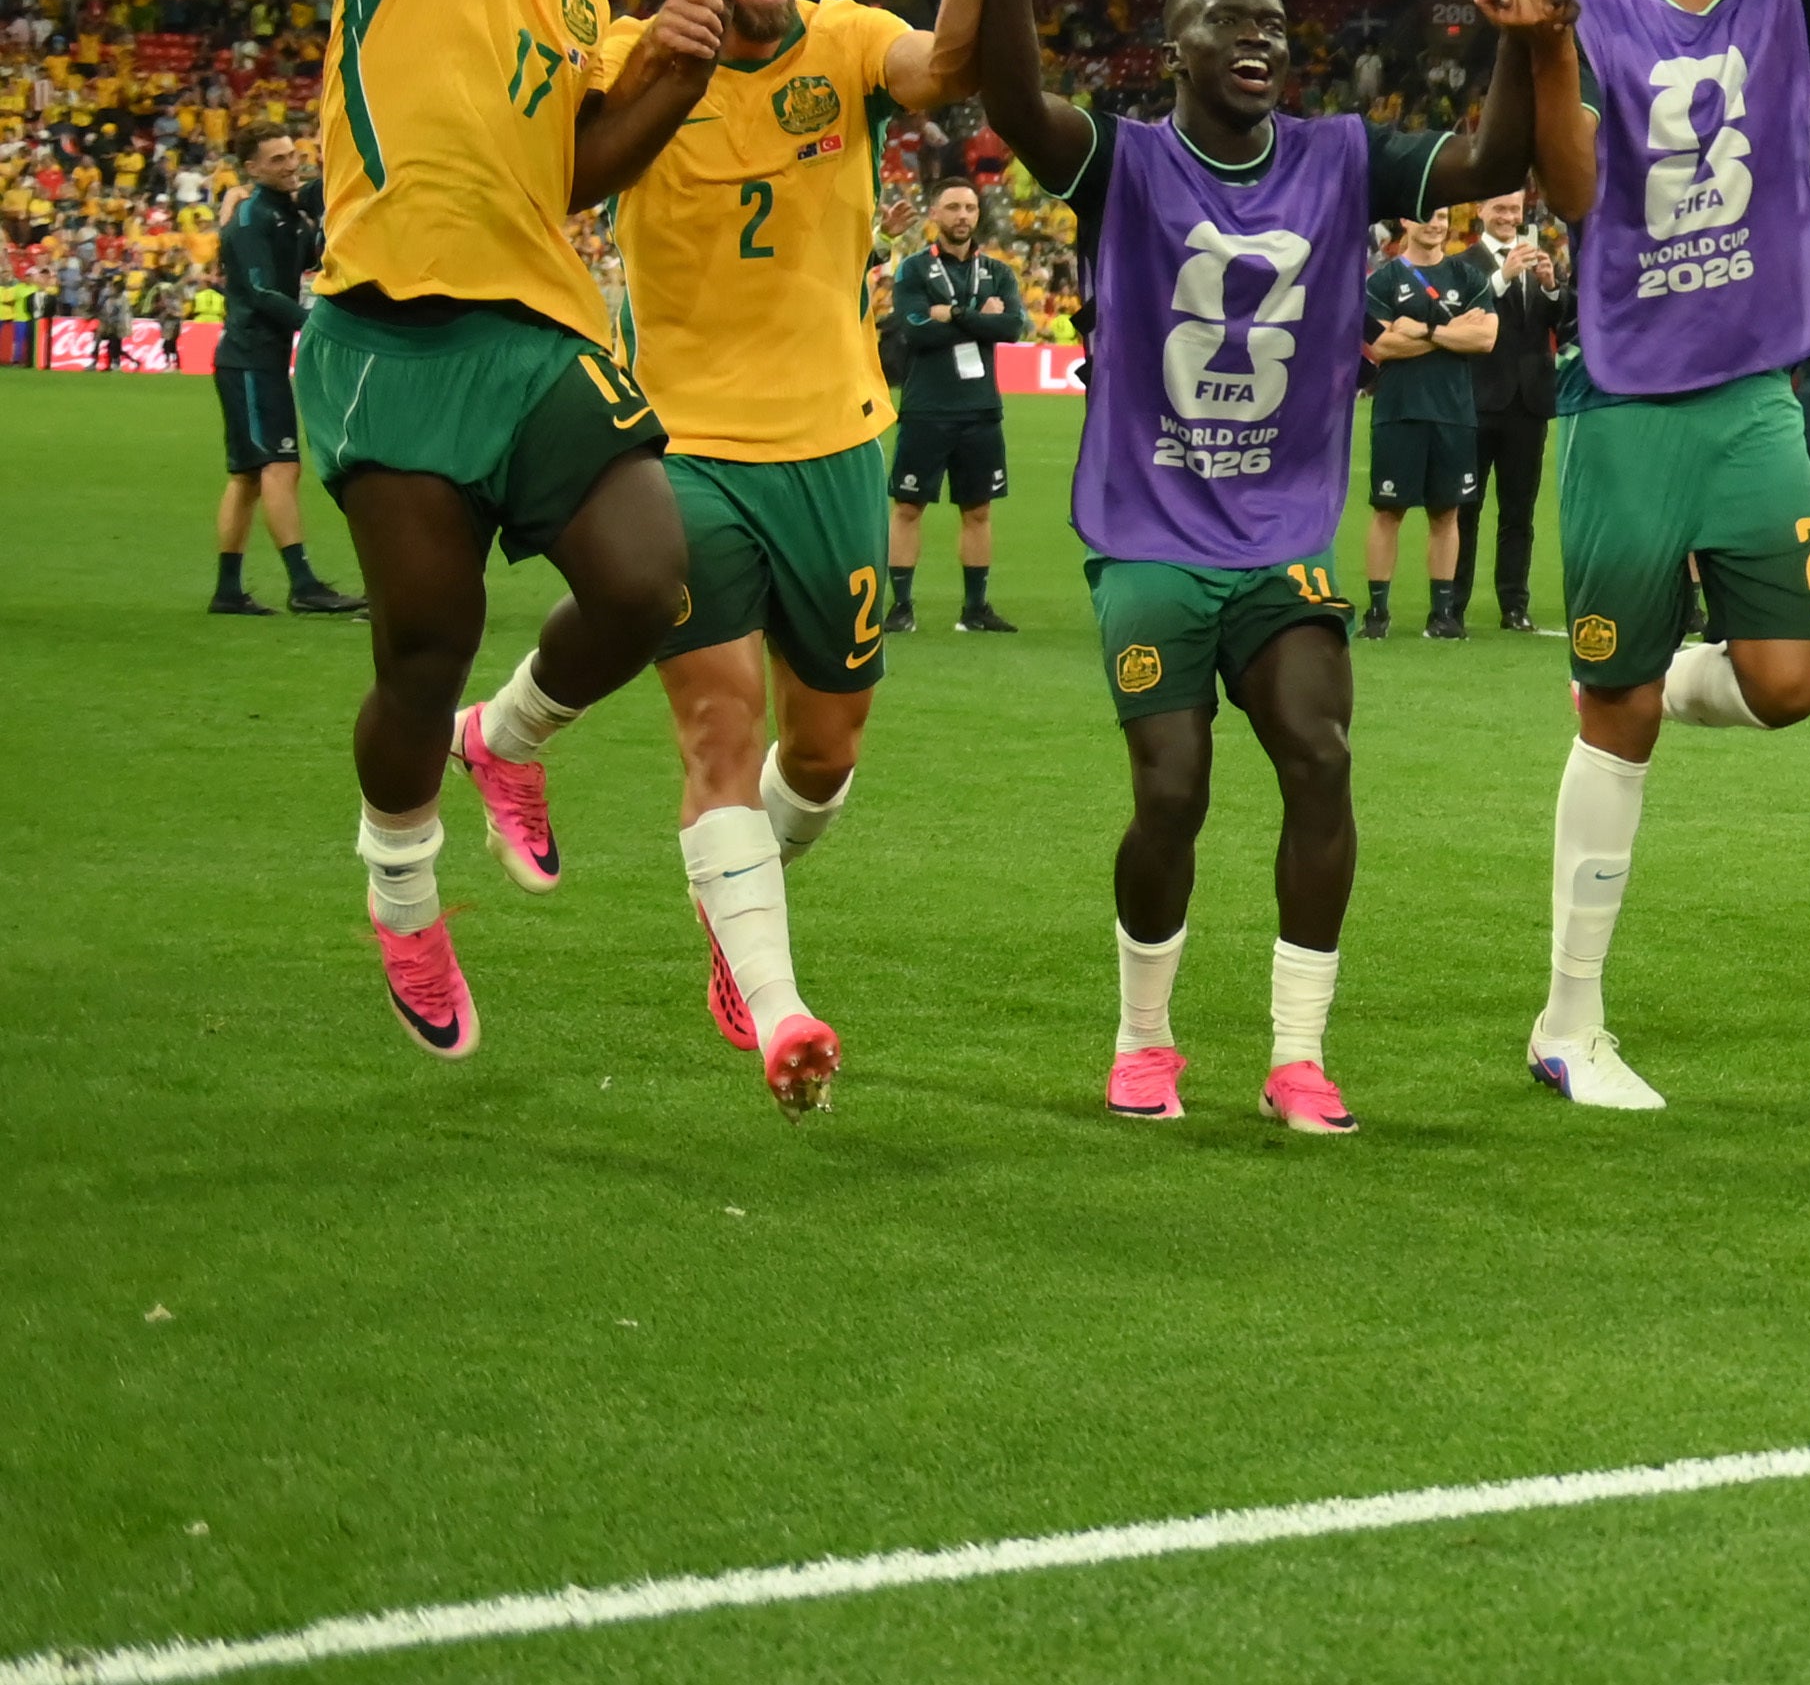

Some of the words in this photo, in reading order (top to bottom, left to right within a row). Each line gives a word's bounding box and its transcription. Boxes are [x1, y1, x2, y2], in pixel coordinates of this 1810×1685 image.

[508, 28, 564, 119] 17
[739, 180, 775, 260] 2
[1673, 188, 1725, 220] FIFA
[1638, 237, 1717, 269] WORLD
[1718, 227, 1750, 253] CUP
[1637, 249, 1755, 299] 2026
[1195, 379, 1255, 403] FIFA
[1160, 414, 1233, 446] WORLD
[1236, 427, 1279, 445] CUP
[1153, 437, 1271, 479] 2026
[849, 566, 881, 644] 2
